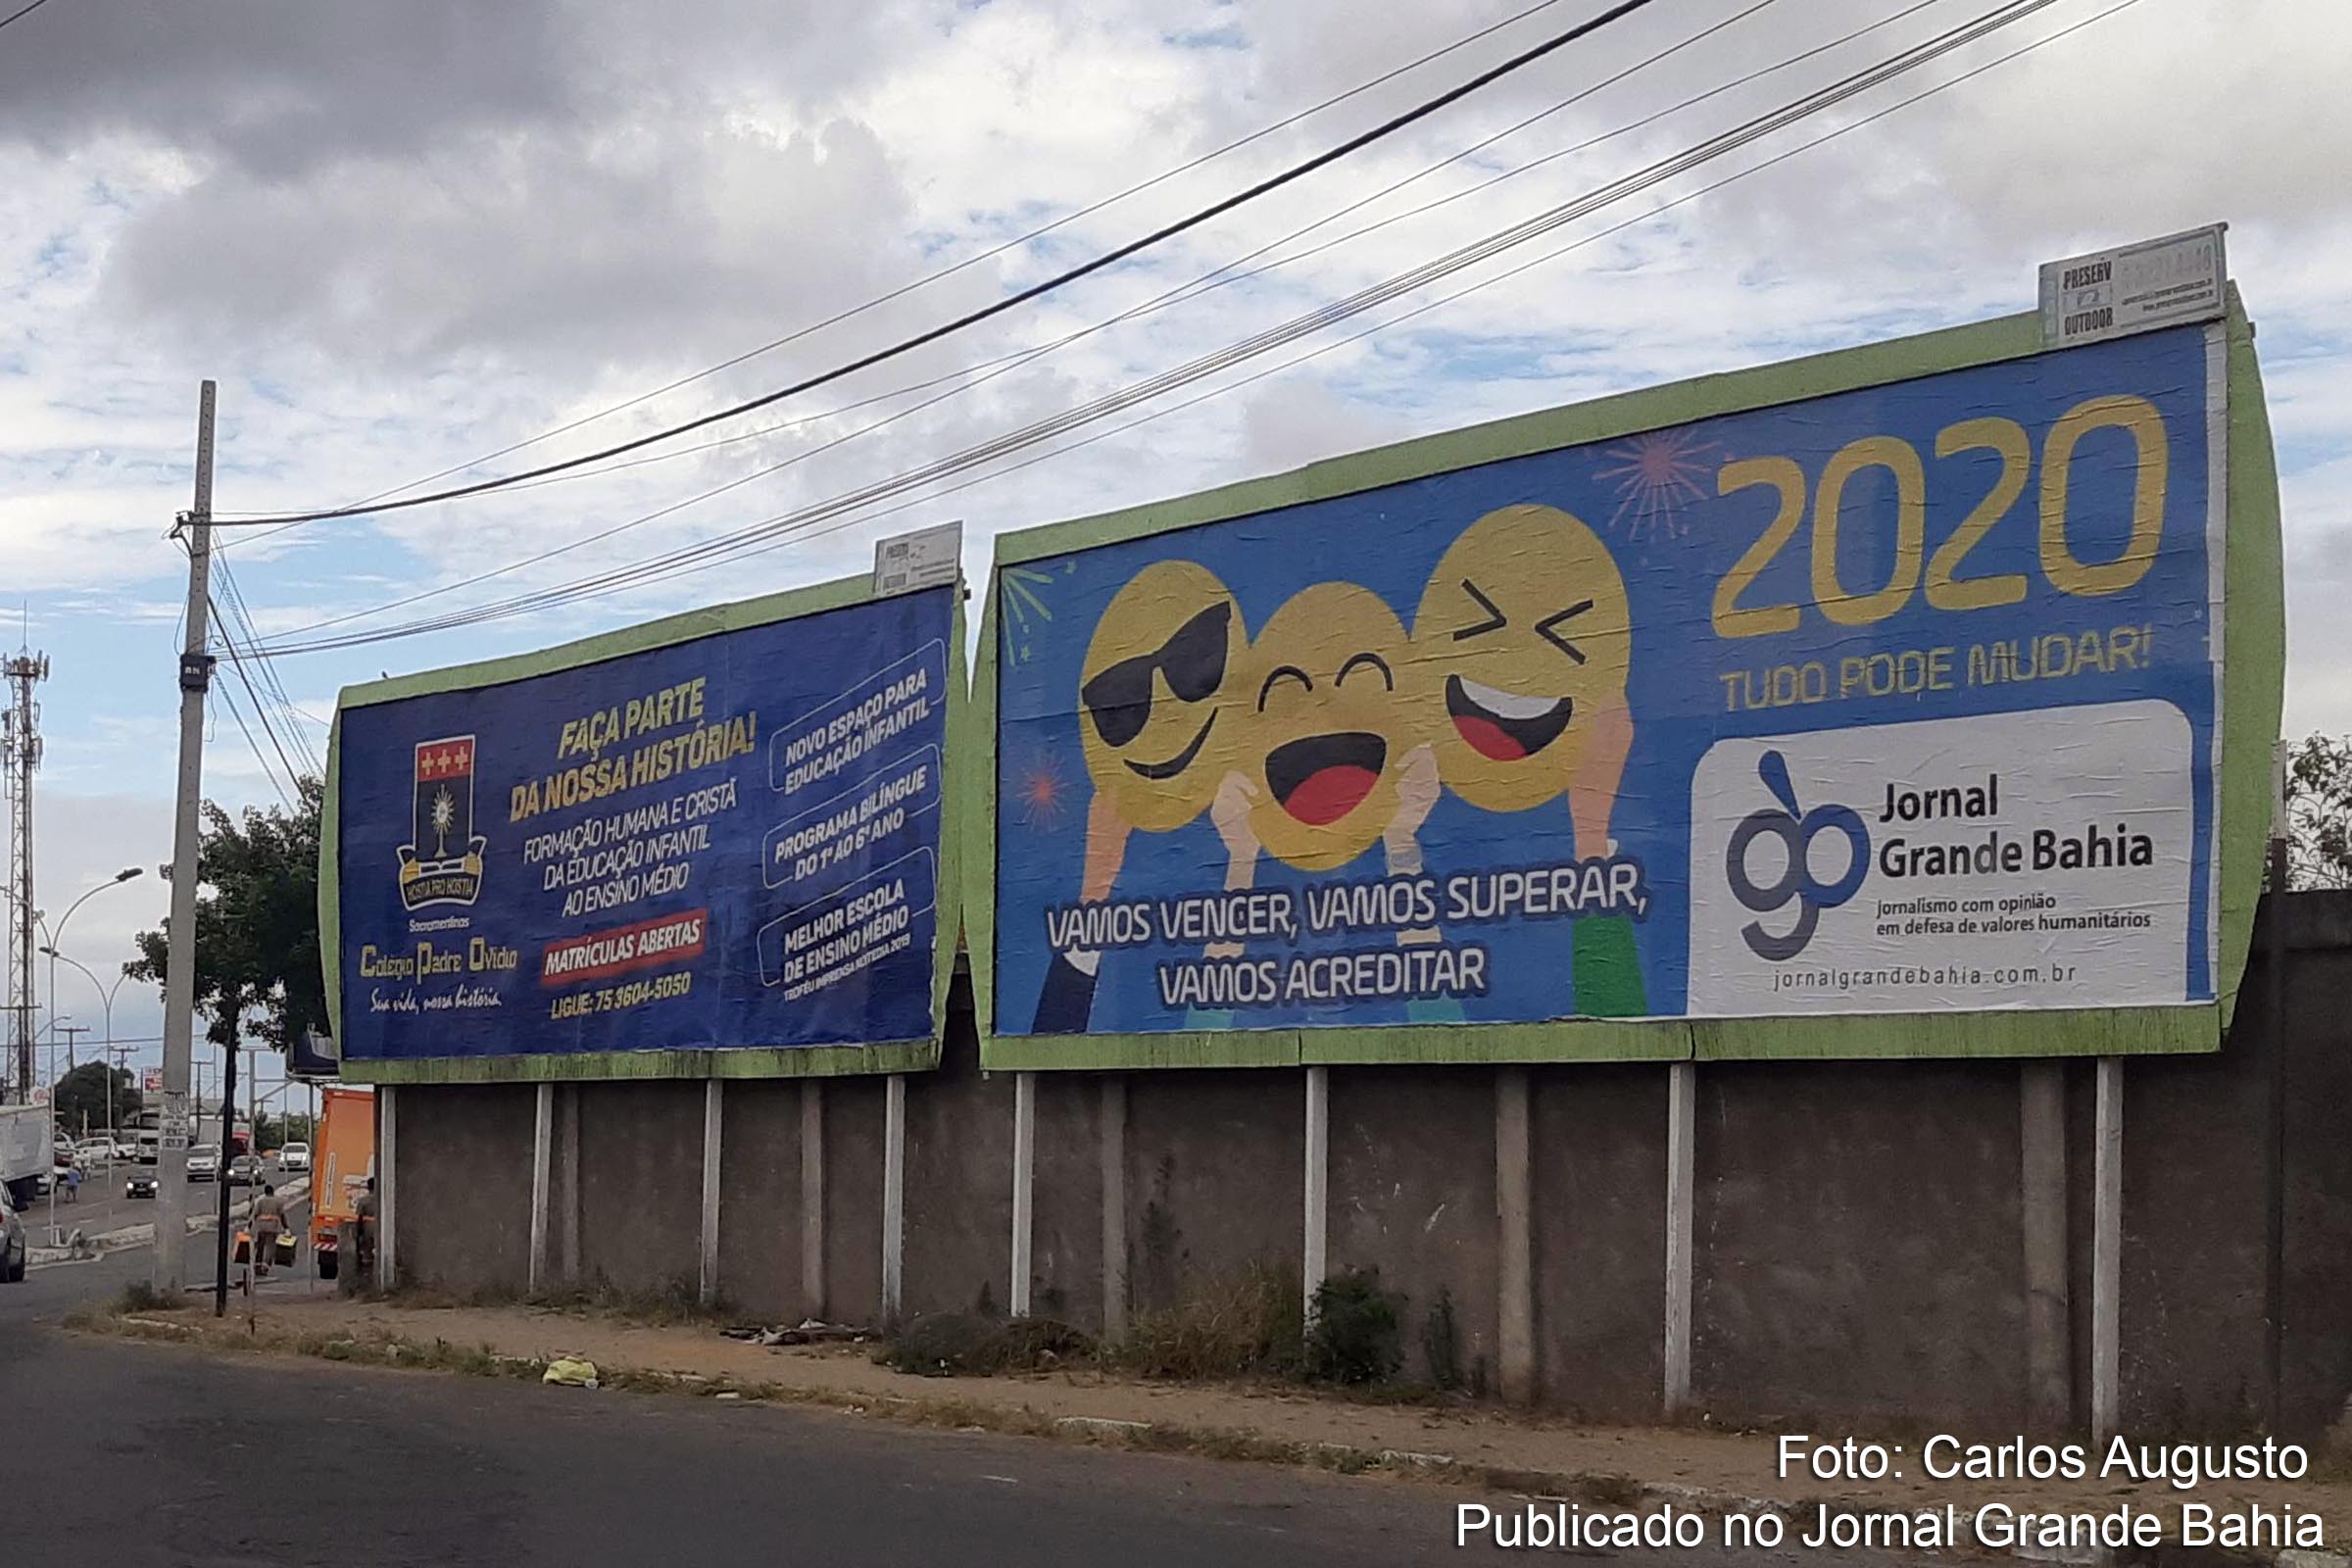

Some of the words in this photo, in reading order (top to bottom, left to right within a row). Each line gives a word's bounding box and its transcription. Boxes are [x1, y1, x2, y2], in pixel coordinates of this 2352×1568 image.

[2064, 307, 2113, 335] OUTDOOR
[1711, 394, 2169, 639] 2020
[1719, 662, 1828, 711] TUDO
[1840, 647, 1955, 699] PODE
[1967, 624, 2153, 686] MUDAR!
[557, 707, 620, 761] FAÇA
[623, 676, 706, 739] PARTE
[785, 727, 826, 767] NOVO
[828, 693, 882, 744] ESPAÇO
[884, 667, 927, 710] PARA
[785, 735, 862, 795] EDUCAÇÃO
[863, 696, 930, 752] INFANTIL
[510, 780, 540, 822] DA
[543, 755, 626, 812] NOSSA
[630, 710, 757, 788] HISTÓRIA!
[1879, 773, 1998, 823] Jornal
[524, 818, 603, 864] FORMAÇÃO
[605, 802, 668, 844] HUMANA
[671, 797, 684, 824] E
[685, 776, 737, 819] CRISTÃ
[774, 806, 858, 863] PROGRAMA
[859, 765, 927, 822] BILÍNGUE
[795, 852, 817, 882] DO
[833, 834, 853, 863] AO
[870, 807, 905, 842] ANO
[543, 865, 564, 891] DA
[566, 839, 644, 884] EDUCAÇÃO
[645, 824, 710, 863] INFANTIL
[1879, 831, 2022, 878] Grande
[2033, 822, 2154, 870] Bahia
[562, 890, 584, 917] AO
[584, 875, 638, 912] ENSINO
[641, 861, 690, 899] MÉDIO
[784, 908, 844, 955] MELHOR
[847, 878, 905, 926] ESCOLA
[1047, 903, 1151, 949] VAMOS
[1160, 893, 1298, 941] VENCER,
[1308, 879, 1436, 930] VAMOS
[1446, 862, 1647, 921] SUPERAR,
[1961, 900, 1994, 914] com
[1998, 894, 2057, 916] opinião
[545, 935, 635, 976] MATRÍCULAS
[637, 918, 702, 956] ABERTAS
[784, 956, 805, 983] DE
[806, 929, 860, 974] ENSINO
[862, 905, 908, 948] MÉDIO
[1877, 923, 1900, 937] em
[1904, 916, 1955, 935] defesa
[1958, 916, 1979, 934] de
[1981, 915, 2035, 933] valores
[2038, 910, 2151, 931] humanitários
[416, 942, 463, 985] Padre
[551, 993, 593, 1020] LIGUE:
[595, 988, 612, 1011] 75
[614, 971, 692, 1009] 3604-5050
[1158, 961, 1276, 1005] VAMOS
[1285, 947, 1485, 999] ACREDITAR
[1773, 962, 2078, 992] jornalgrandebahia.com.br
[369, 988, 390, 1014] Sua
[422, 996, 453, 1011] nossa
